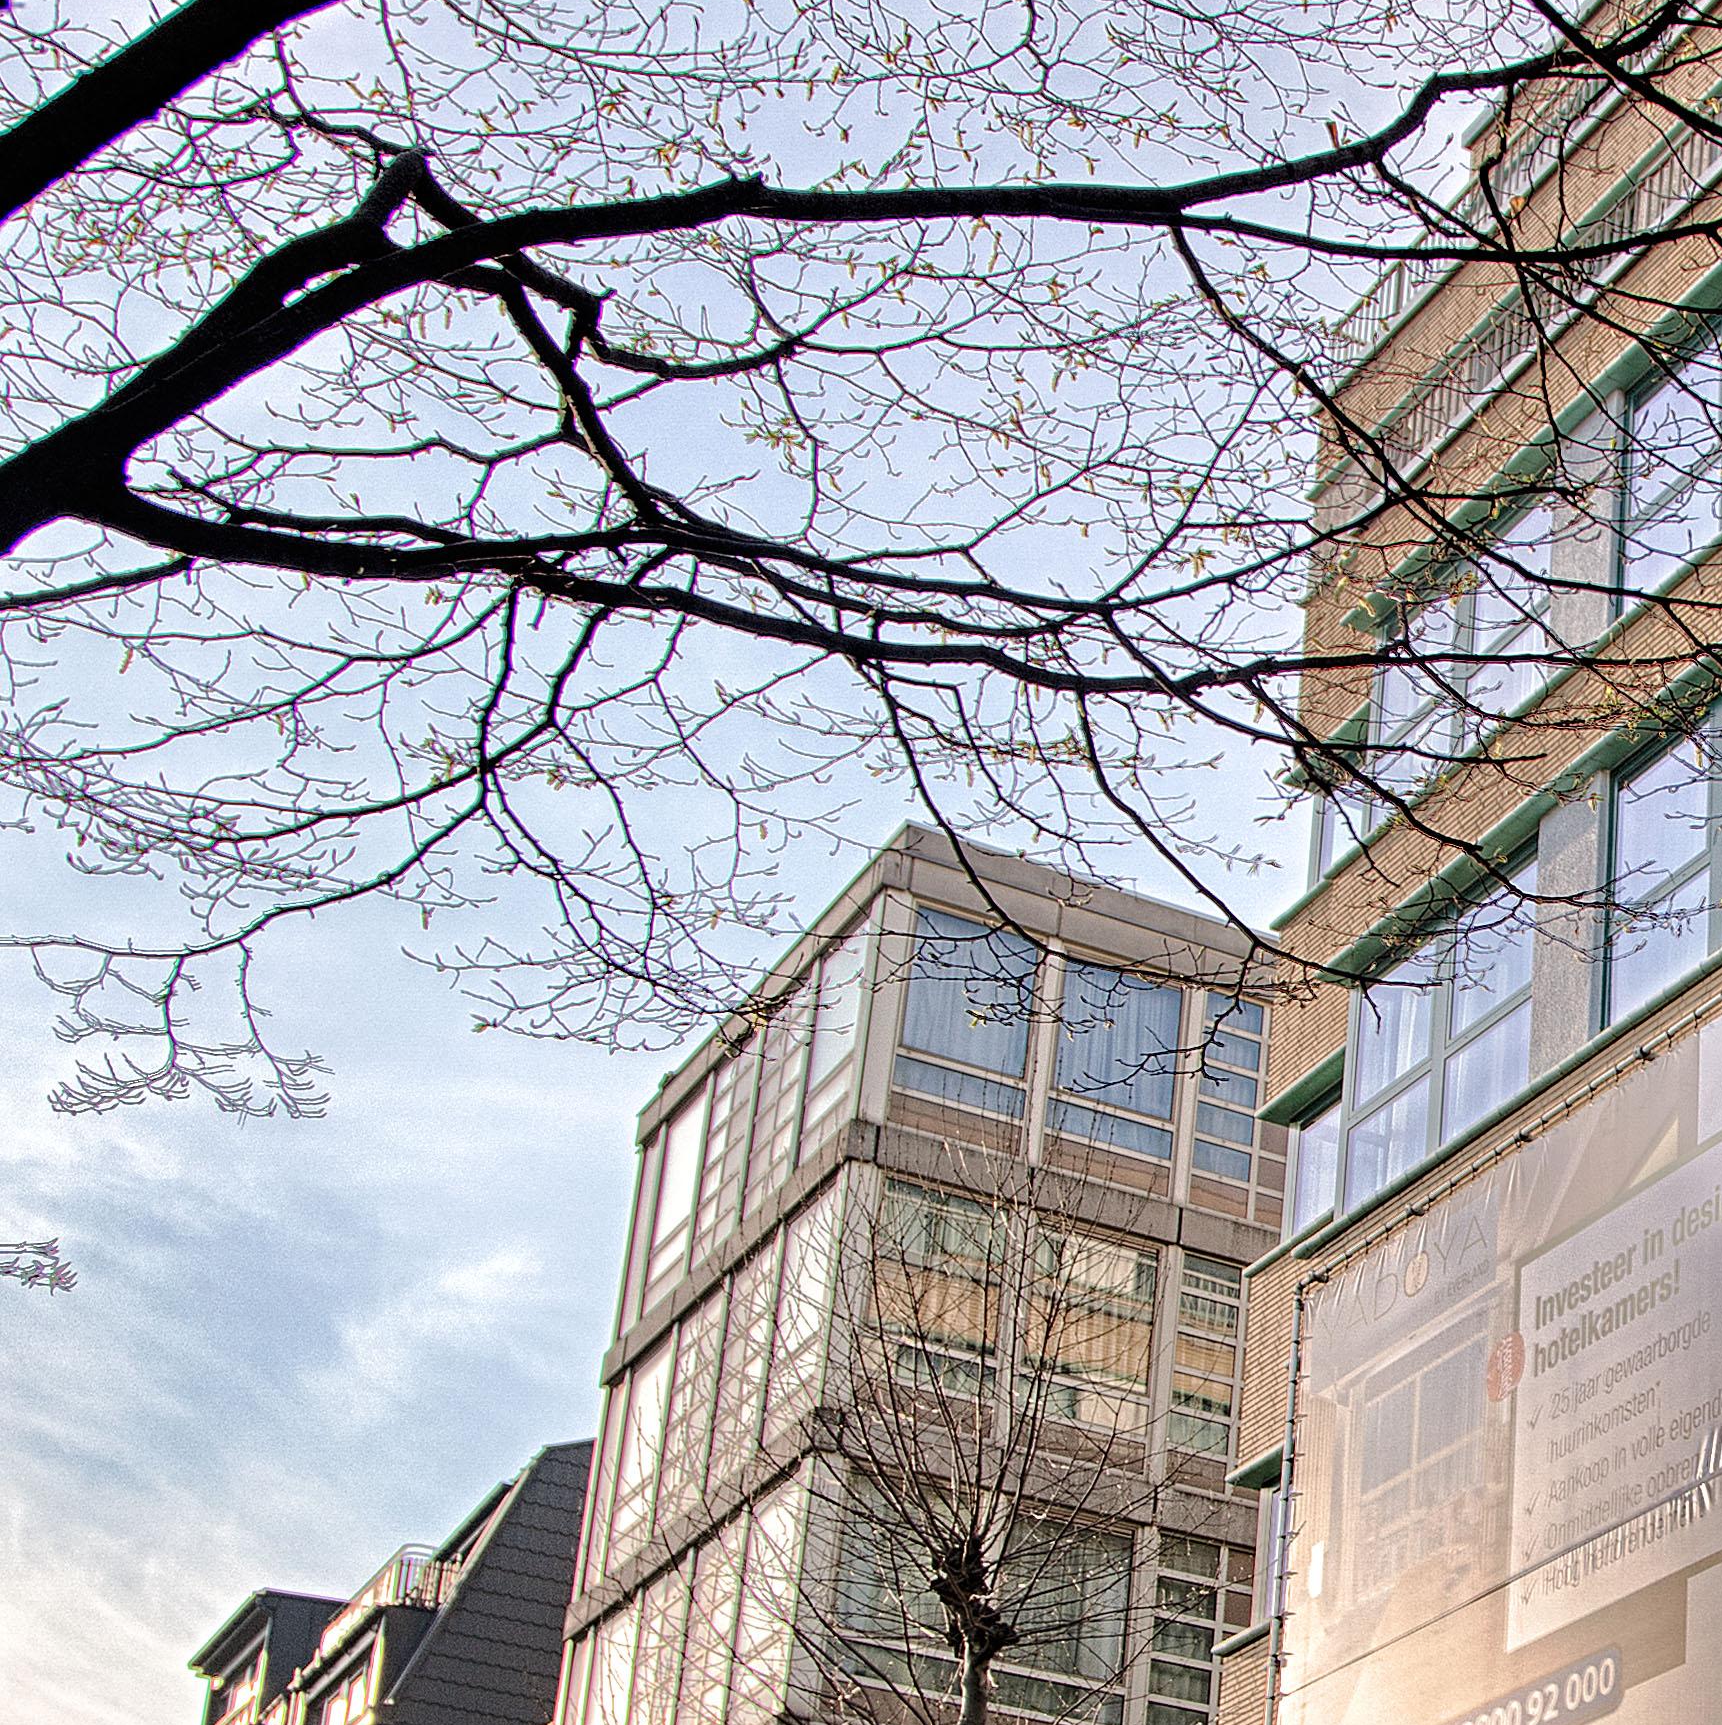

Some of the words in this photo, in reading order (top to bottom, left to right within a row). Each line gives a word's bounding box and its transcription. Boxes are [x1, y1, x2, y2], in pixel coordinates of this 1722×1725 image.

[1533, 1258, 1681, 1378] hotelkamers!
[1535, 1242, 1637, 1331] Investeer
[1643, 1227, 1665, 1266] in
[1551, 1386, 1570, 1421] 25
[1573, 1374, 1601, 1415] jaar
[1604, 1309, 1712, 1395] gewaarborgde
[1566, 1657, 1616, 1711] 000
